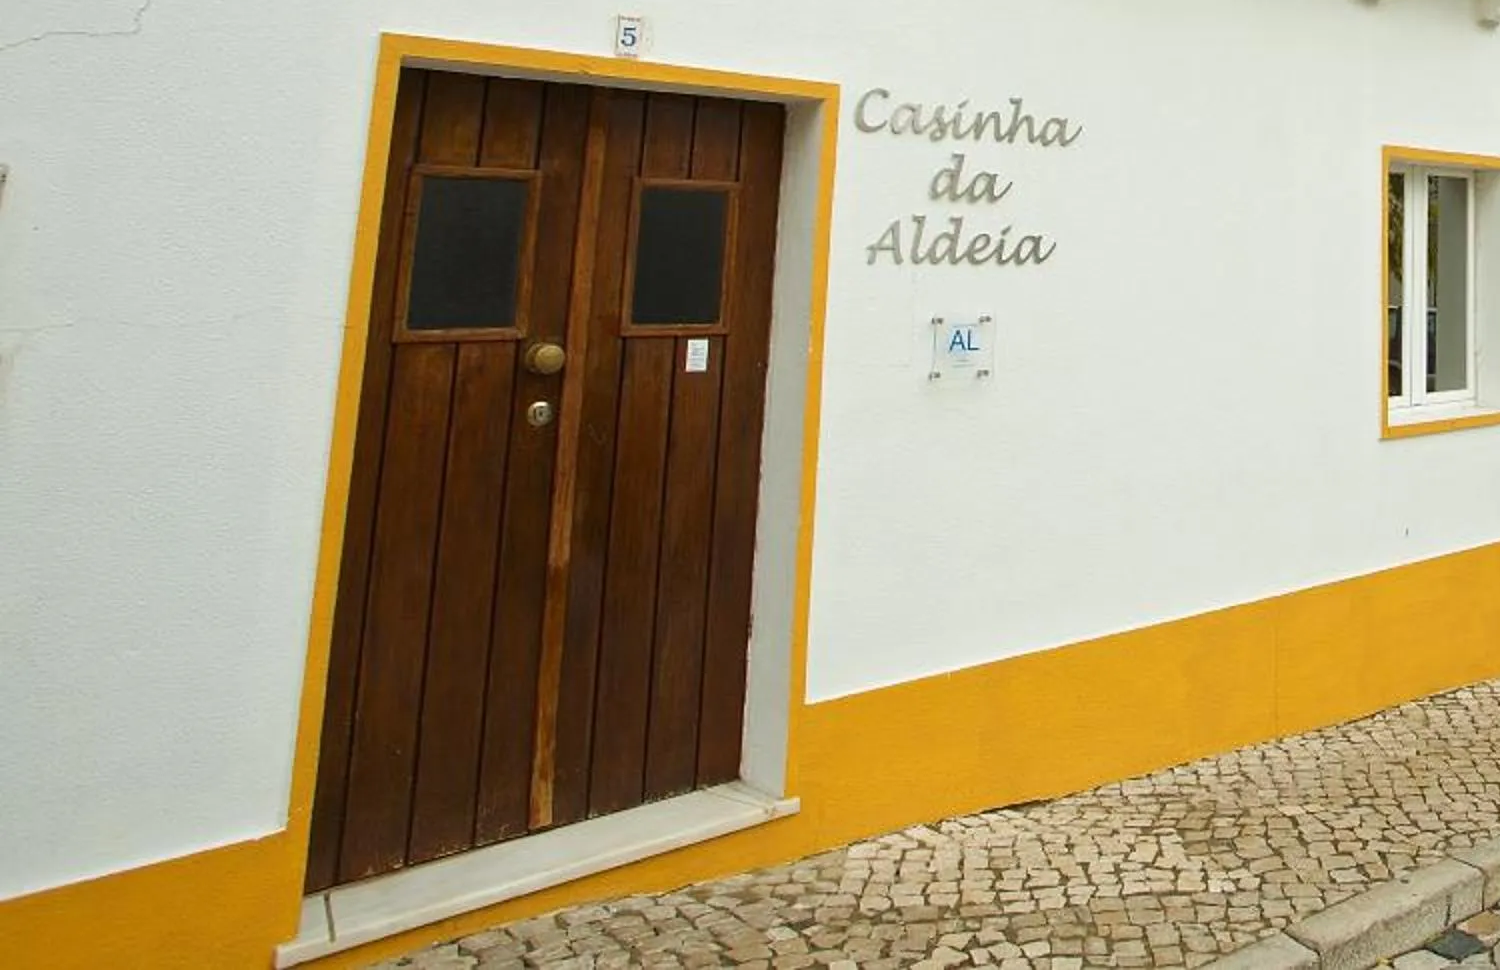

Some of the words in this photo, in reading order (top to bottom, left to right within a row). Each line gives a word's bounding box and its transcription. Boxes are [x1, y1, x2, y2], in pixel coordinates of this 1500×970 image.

[621, 27, 637, 47] 5
[929, 153, 1013, 204] da
[948, 329, 980, 351] AL
